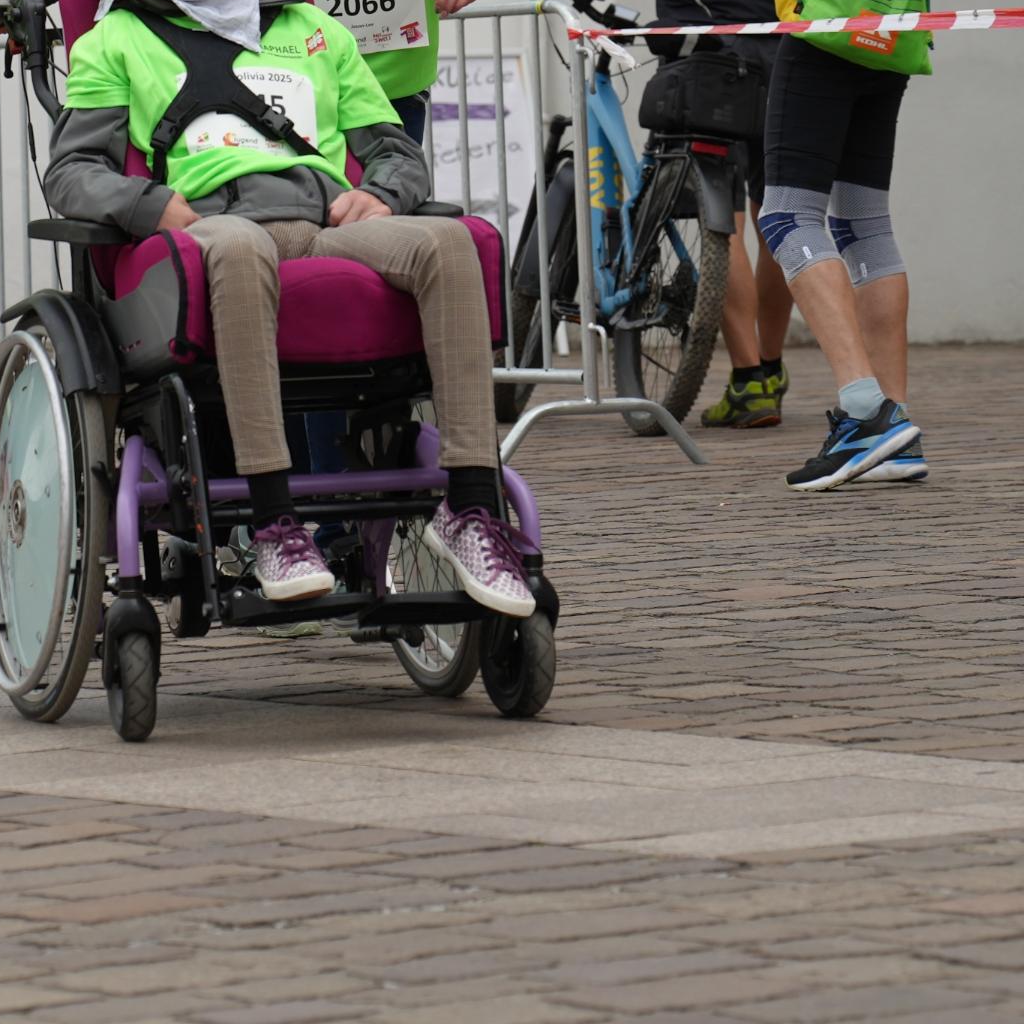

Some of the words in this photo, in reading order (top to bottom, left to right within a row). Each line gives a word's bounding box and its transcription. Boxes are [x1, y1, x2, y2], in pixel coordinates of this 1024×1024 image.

[263, 45, 301, 54] APHAEL
[238, 71, 265, 81] olivia
[268, 73, 293, 83] 2025
